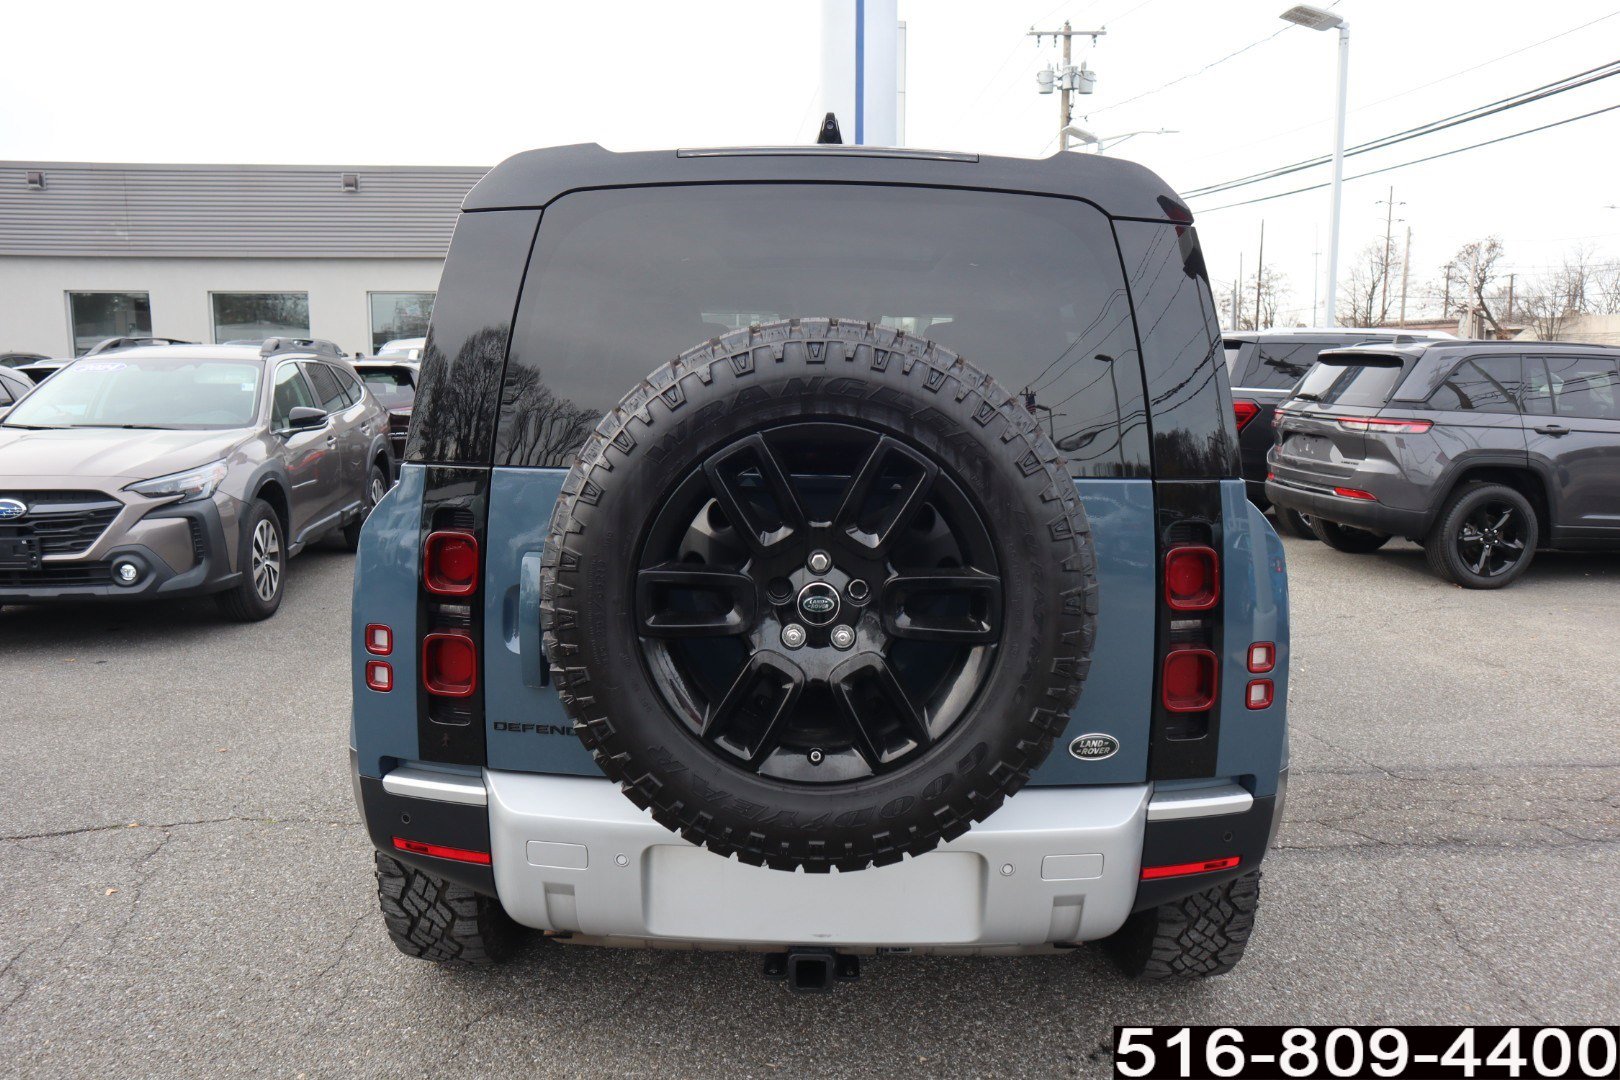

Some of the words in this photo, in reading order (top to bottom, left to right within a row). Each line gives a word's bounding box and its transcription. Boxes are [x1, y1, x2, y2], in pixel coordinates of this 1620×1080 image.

[644, 375, 992, 464] WRANGLER
[1080, 739, 1104, 748] LAND
[1081, 746, 1111, 755] ROVER
[647, 741, 987, 830] GOODYEAR
